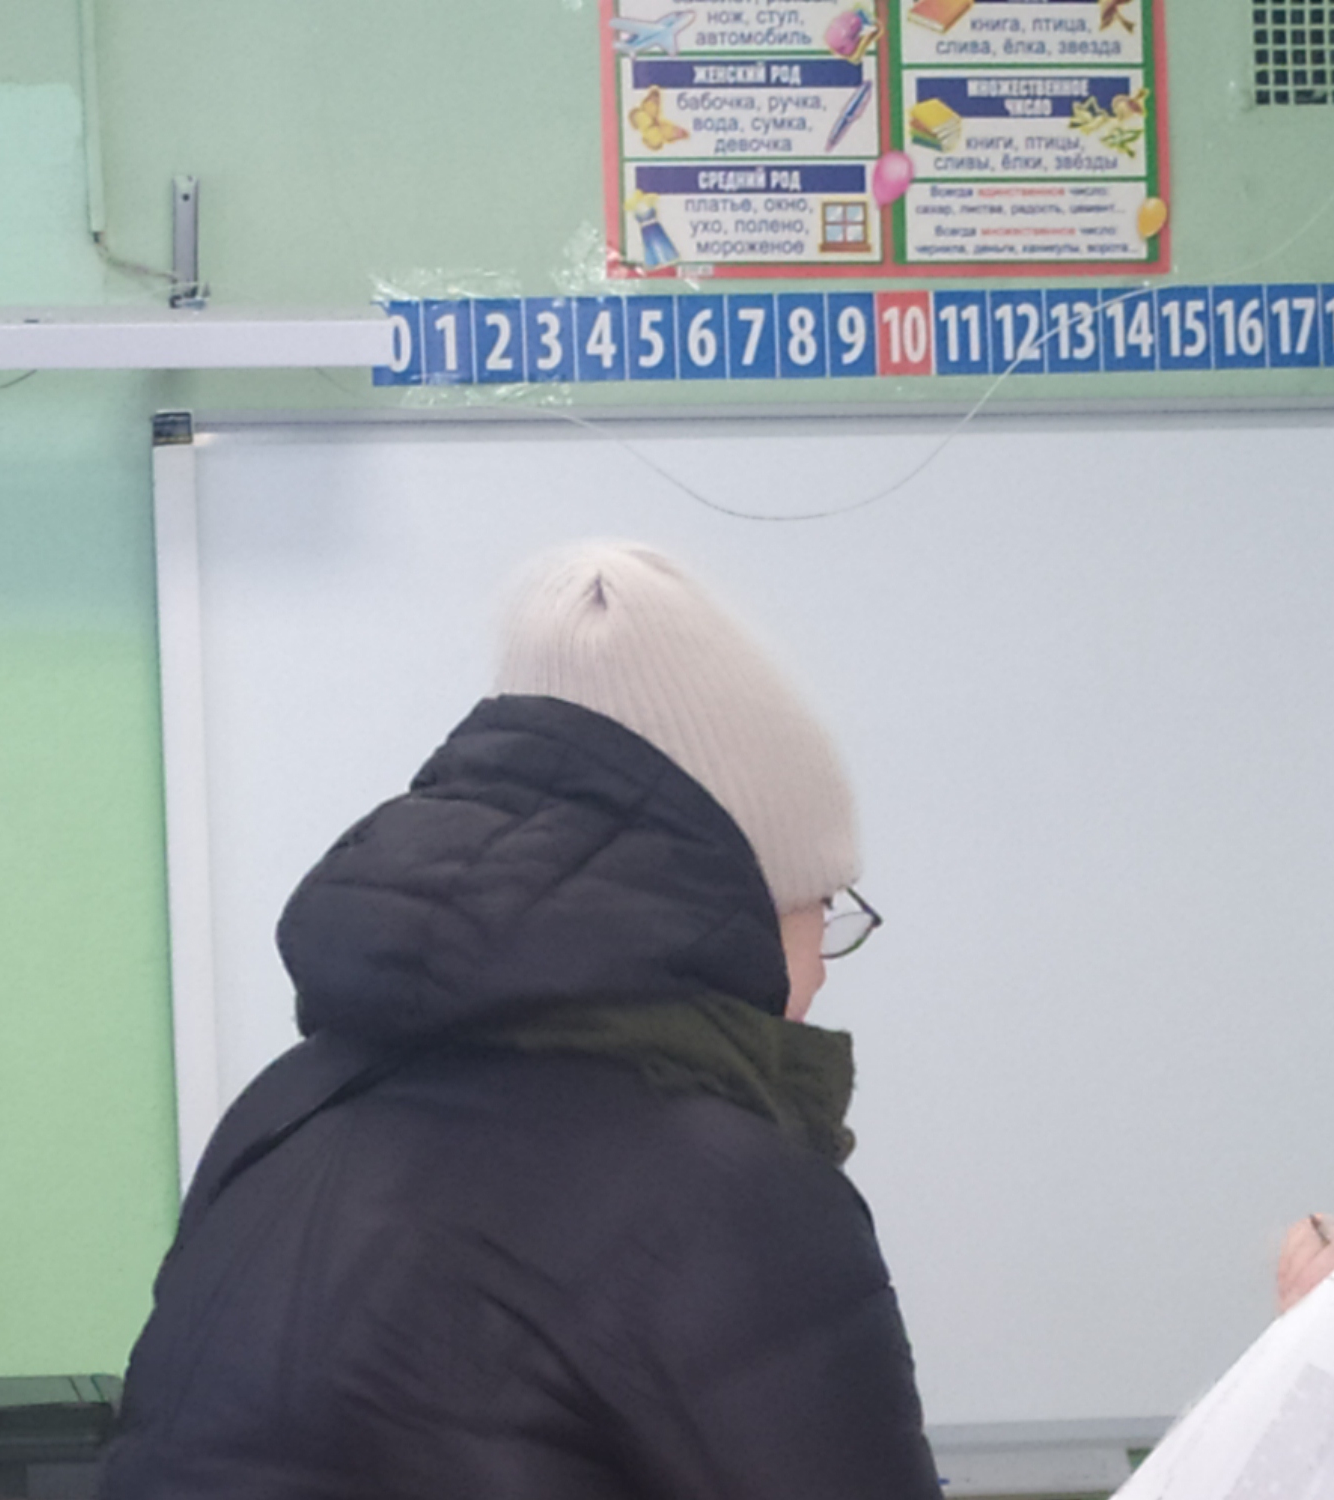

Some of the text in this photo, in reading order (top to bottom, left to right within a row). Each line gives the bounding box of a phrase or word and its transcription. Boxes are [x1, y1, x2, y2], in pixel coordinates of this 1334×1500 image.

[756, 10, 804, 27] стул,
[970, 17, 1091, 33] книга, птица,
[695, 27, 811, 46] автомобиль
[936, 39, 1121, 57] слива, ёлка, звезда
[693, 62, 801, 86] ЖЕНСКИЙ РОД
[676, 92, 827, 116] бабочка, ручка,
[692, 118, 812, 137] вода, сумка,
[714, 137, 792, 154] девочка
[966, 135, 1085, 151] книги, птицы,
[934, 154, 1118, 172] сливы, ёлки, звёзды
[698, 168, 801, 191] СРЕДНИЙ РОД
[685, 198, 813, 215] платье, окно,
[689, 218, 810, 238] ухо, полено,
[697, 240, 804, 257] мороженое
[390, 314, 412, 372] 0
[435, 314, 458, 371] 1
[485, 313, 514, 370] 2
[536, 312, 563, 369] 3
[586, 311, 616, 368] 4
[639, 310, 665, 367] 5
[687, 309, 714, 366] 6
[737, 308, 766, 365] 7
[788, 307, 817, 365] 8
[837, 306, 866, 364] 9
[882, 306, 927, 363] 10
[939, 303, 981, 362] 11
[994, 303, 1042, 361] 12
[1050, 302, 1097, 360] 13
[1105, 301, 1153, 359] 14
[1161, 300, 1206, 358] 15
[1215, 299, 1263, 356] 16
[1271, 298, 1317, 354] 17
